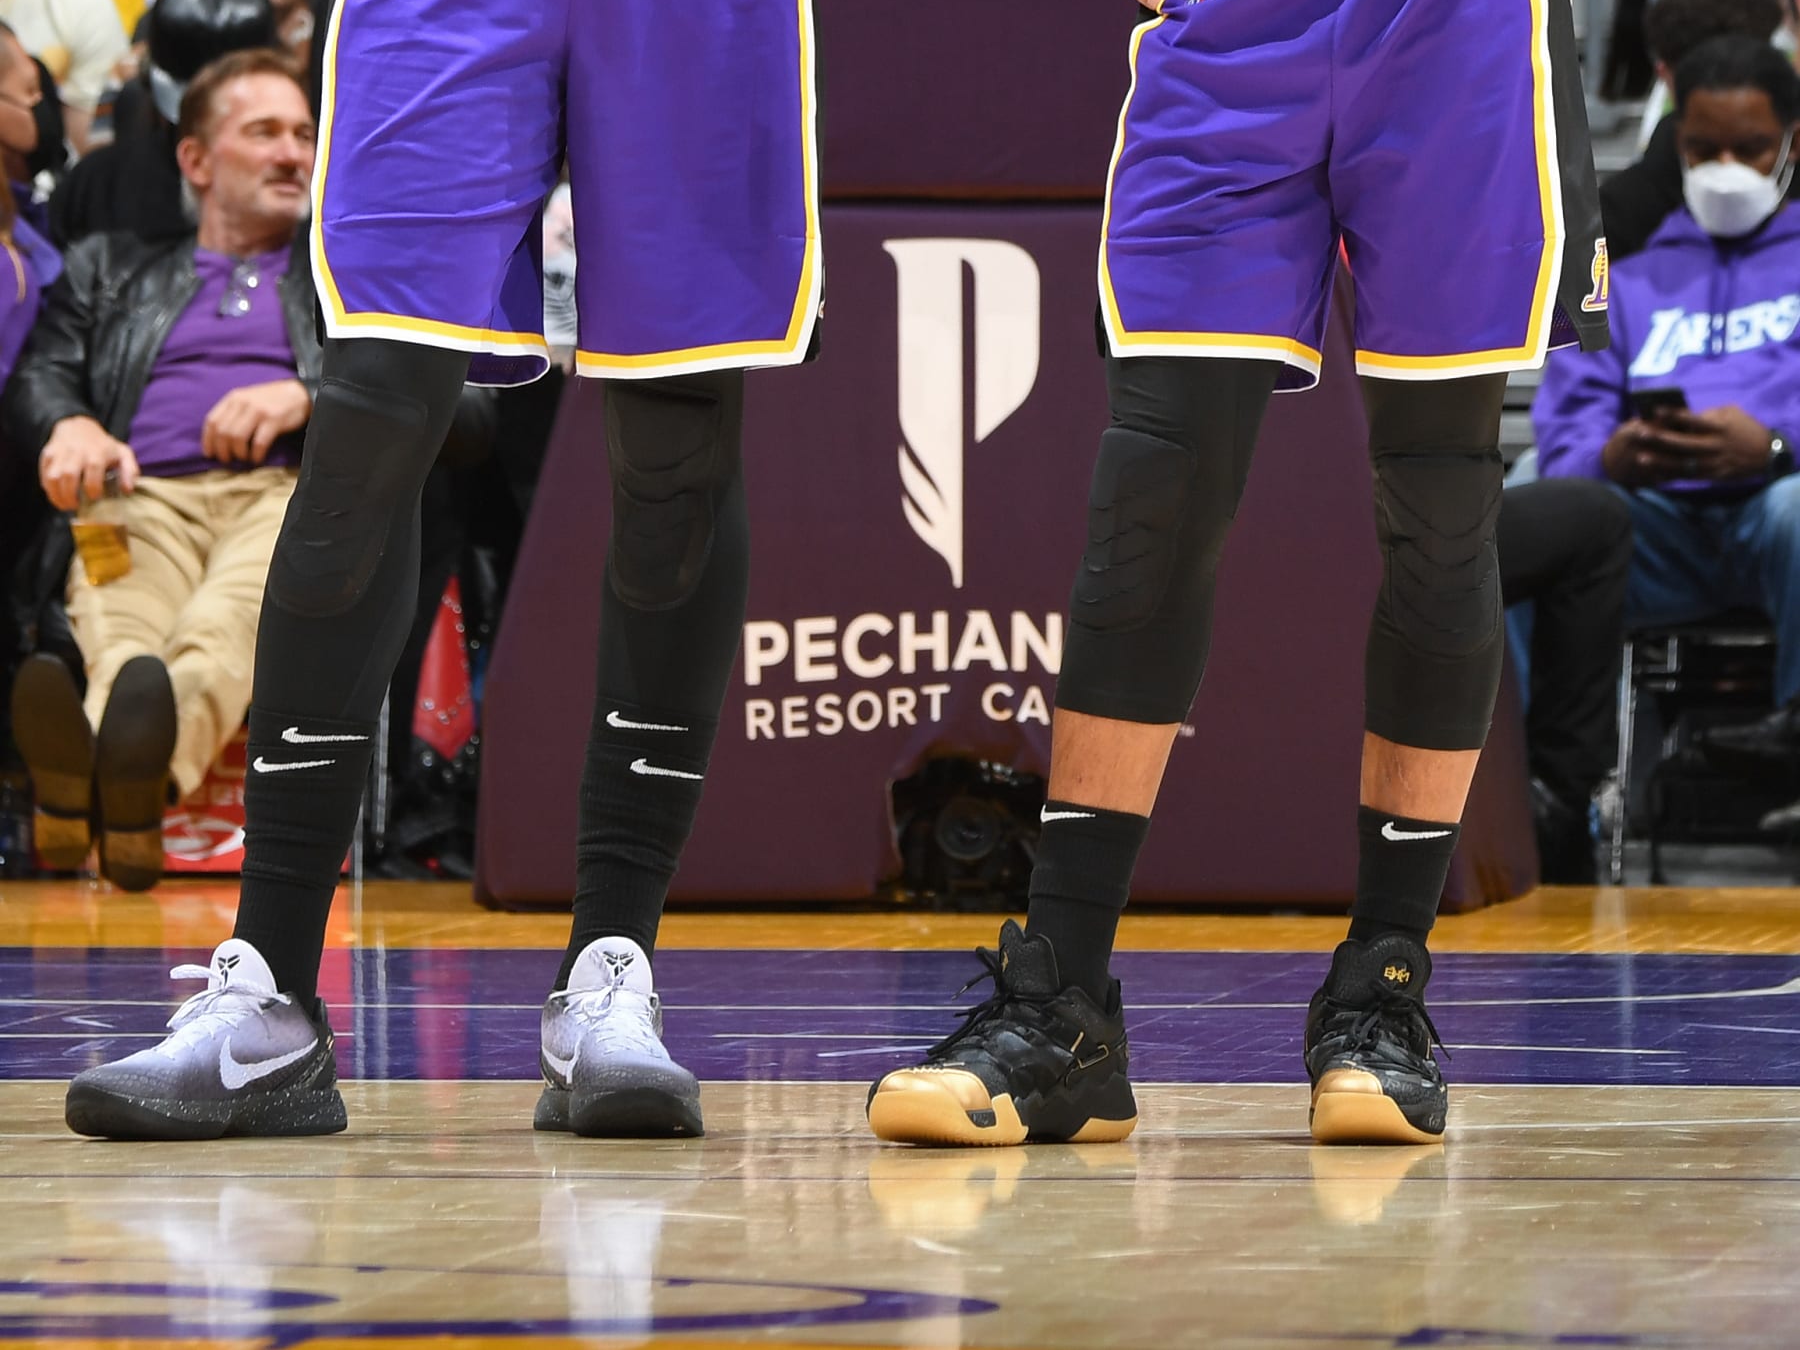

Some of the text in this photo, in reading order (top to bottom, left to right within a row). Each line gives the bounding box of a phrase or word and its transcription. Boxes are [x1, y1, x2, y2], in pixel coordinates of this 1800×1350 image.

[744, 610, 1063, 686] PECHAN
[745, 682, 1051, 740] RESORT CA
